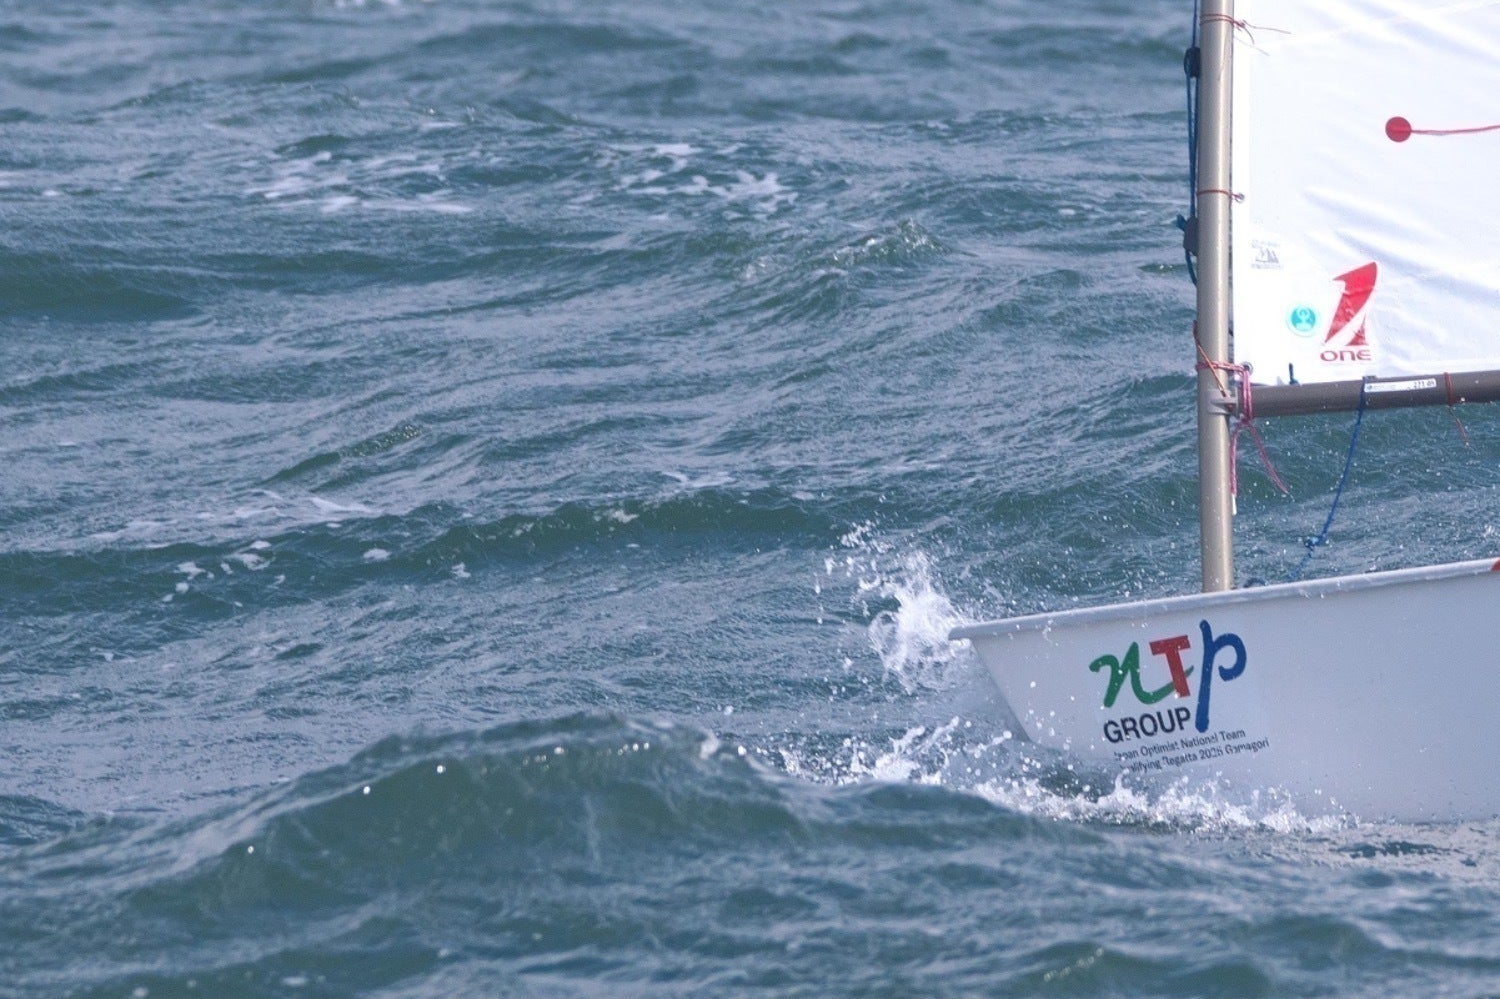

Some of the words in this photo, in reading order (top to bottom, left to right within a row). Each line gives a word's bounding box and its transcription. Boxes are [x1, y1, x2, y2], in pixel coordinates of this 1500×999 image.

[1103, 706, 1191, 744] GROUP
[1140, 739, 1179, 758] Optimist
[1180, 732, 1218, 749] National
[1220, 728, 1246, 742] Team
